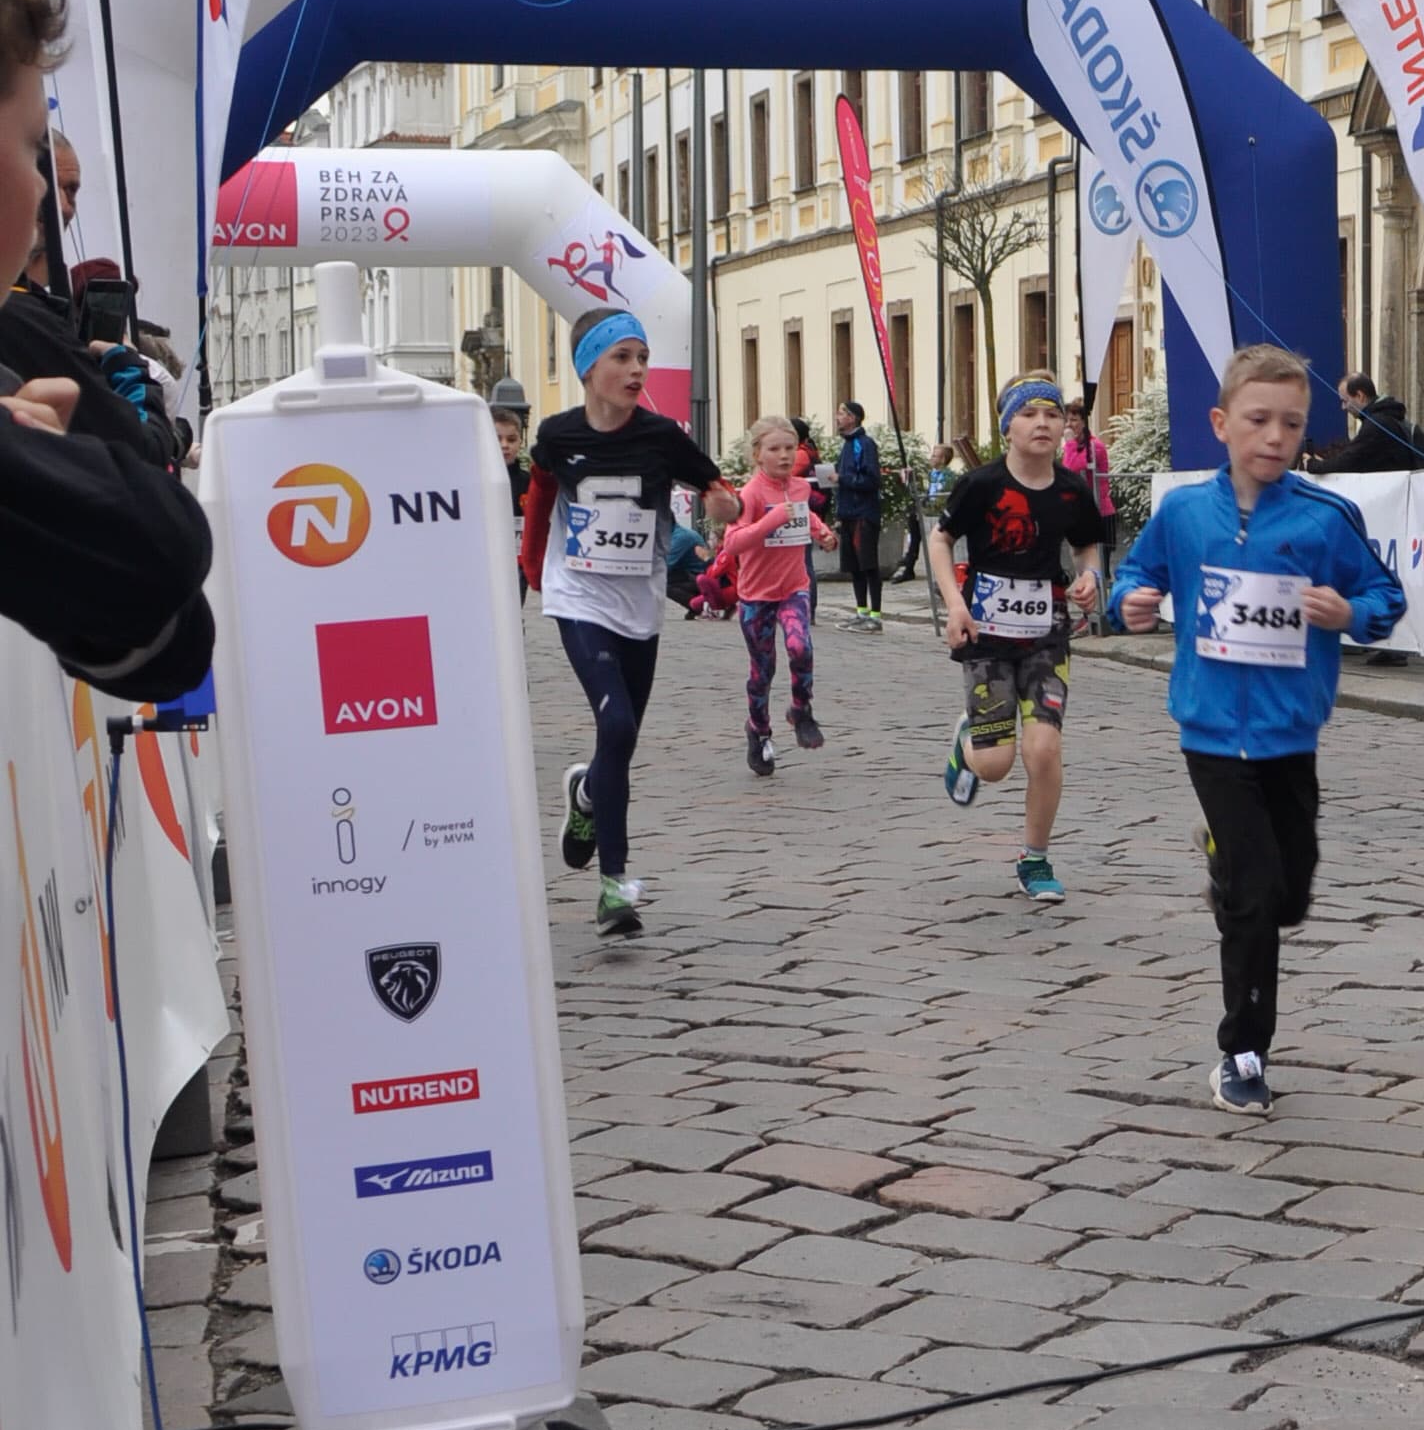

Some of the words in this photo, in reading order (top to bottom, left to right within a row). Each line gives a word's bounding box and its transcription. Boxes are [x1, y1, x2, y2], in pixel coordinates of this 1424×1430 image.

[320, 168, 361, 183] BĚH
[372, 170, 399, 183] ZA
[320, 185, 408, 202] ZDRAVÁ
[321, 207, 375, 221] PRSA
[213, 223, 286, 241] AVON
[320, 226, 378, 242] 2023
[389, 489, 461, 525] NN
[595, 531, 648, 549] 3457
[997, 598, 1047, 615] 3469
[1231, 603, 1302, 630] 3484
[336, 696, 424, 724] AVON
[424, 819, 475, 833] Powered
[424, 836, 439, 847] by
[444, 833, 475, 844] MVM
[312, 875, 387, 895] innogy
[372, 948, 433, 962] PEUGEOT
[359, 1075, 474, 1108] NUTREND
[407, 1240, 502, 1275] ŠKODA
[390, 1340, 493, 1379] KPMG
